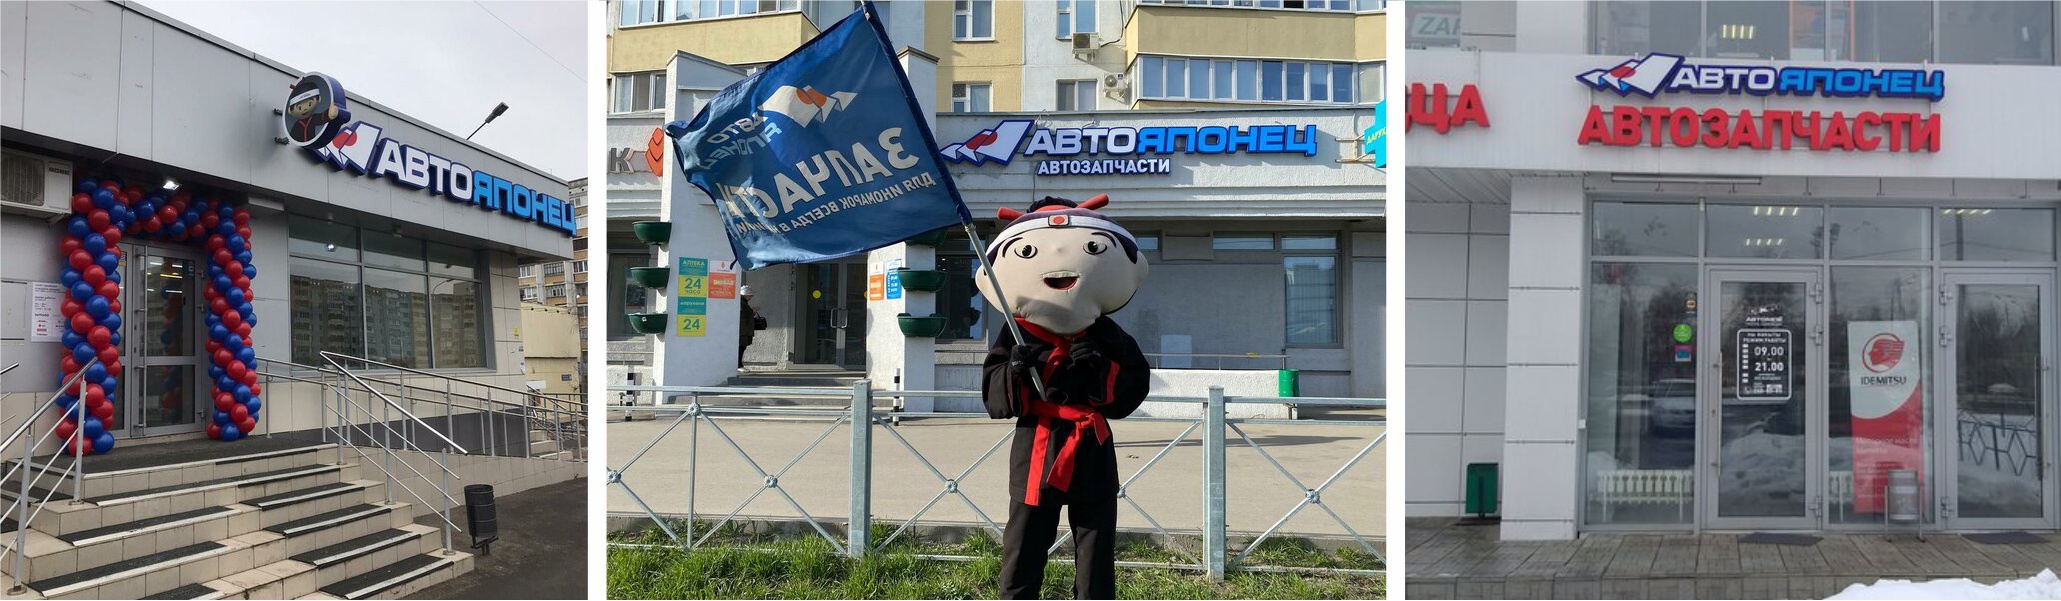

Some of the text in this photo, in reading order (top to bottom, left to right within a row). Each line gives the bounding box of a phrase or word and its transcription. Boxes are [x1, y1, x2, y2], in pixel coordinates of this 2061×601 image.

[1405, 83, 1490, 135] ЦА
[1577, 105, 1941, 152] АВТОЗАПЧАСТИ
[1024, 124, 1317, 157] АВТОЯПОНЕЦ
[1037, 158, 1171, 176] АВТОЗАПЧАСТИ
[373, 137, 577, 237] АВТОЯПОНЕЦ
[684, 277, 702, 290] 24
[683, 318, 700, 330] 24
[1754, 346, 1785, 356] 09.00
[1755, 362, 1785, 372] 21.00
[1861, 376, 1907, 386] IDEMITSU
